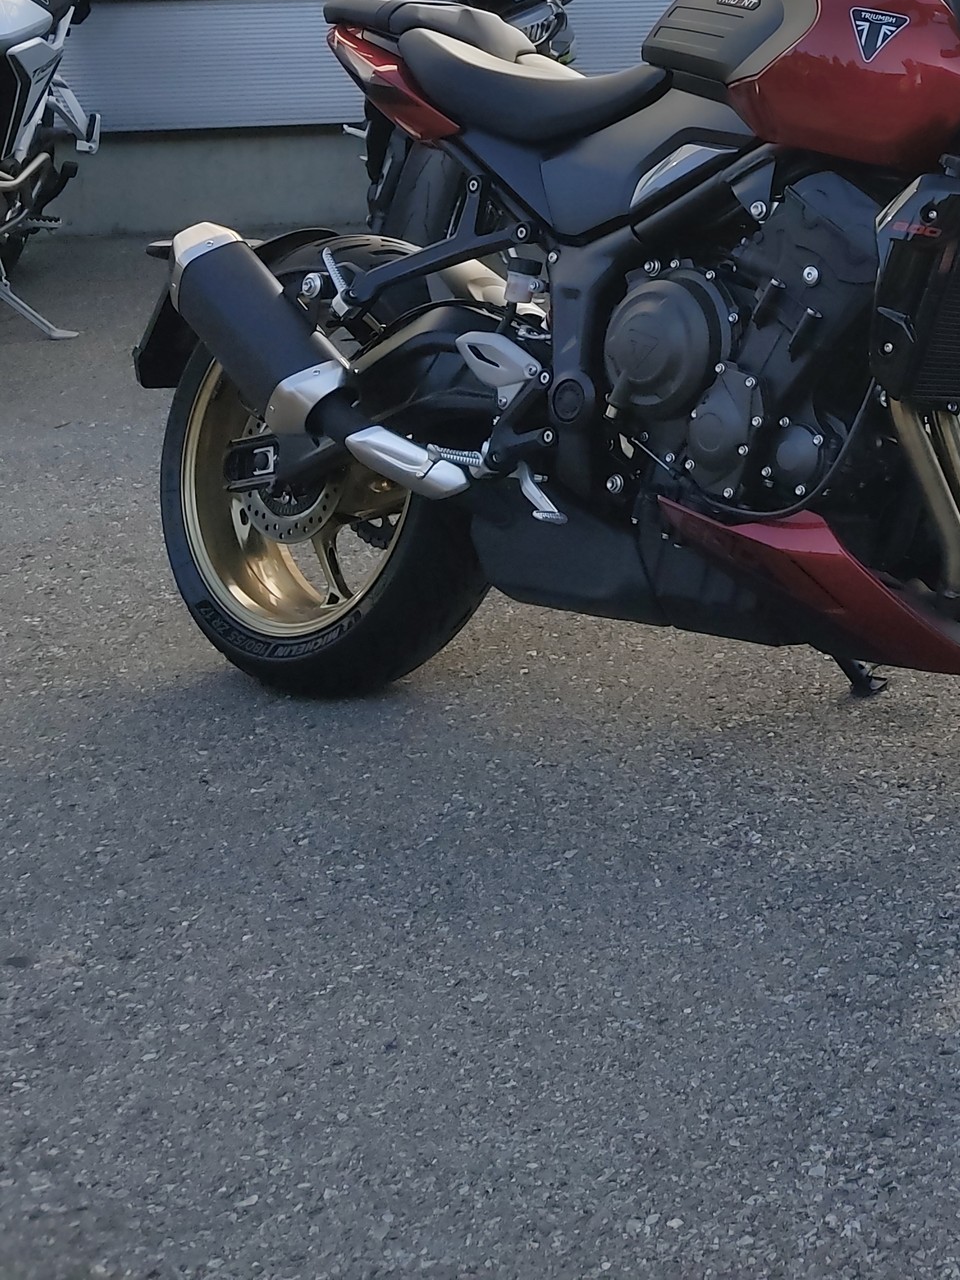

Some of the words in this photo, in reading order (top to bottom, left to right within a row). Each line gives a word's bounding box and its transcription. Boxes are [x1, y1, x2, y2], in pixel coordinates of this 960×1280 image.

[861, 11, 896, 24] TRIUMPH
[230, 631, 267, 655] 180/55
[275, 627, 341, 657] MICHELIN
